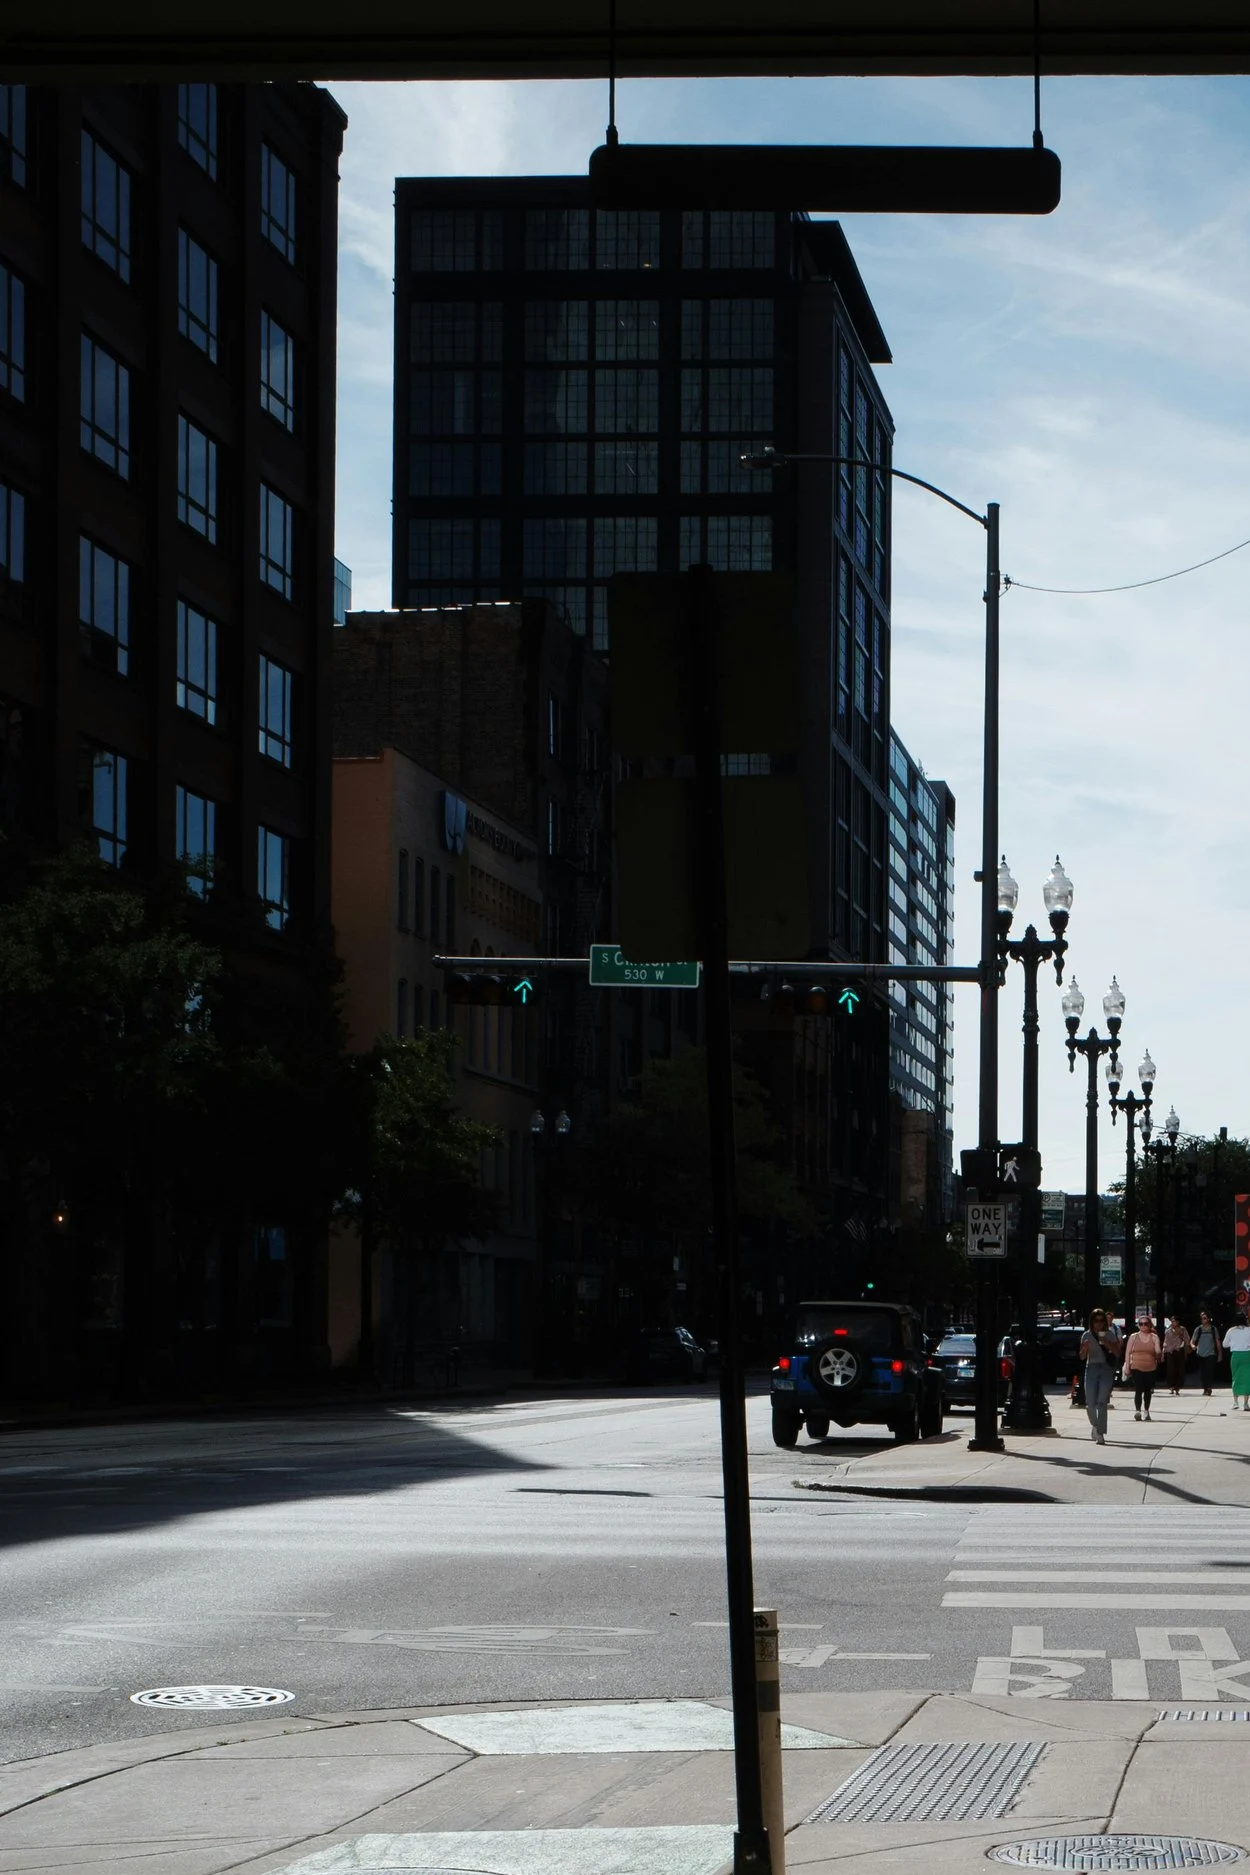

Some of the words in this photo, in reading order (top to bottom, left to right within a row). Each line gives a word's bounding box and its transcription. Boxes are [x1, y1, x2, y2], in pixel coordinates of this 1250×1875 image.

[602, 952, 609, 963] S
[624, 969, 647, 980] 530
[655, 969, 665, 981] W
[971, 1207, 1002, 1221] ONE
[970, 1223, 1002, 1235] WAY
